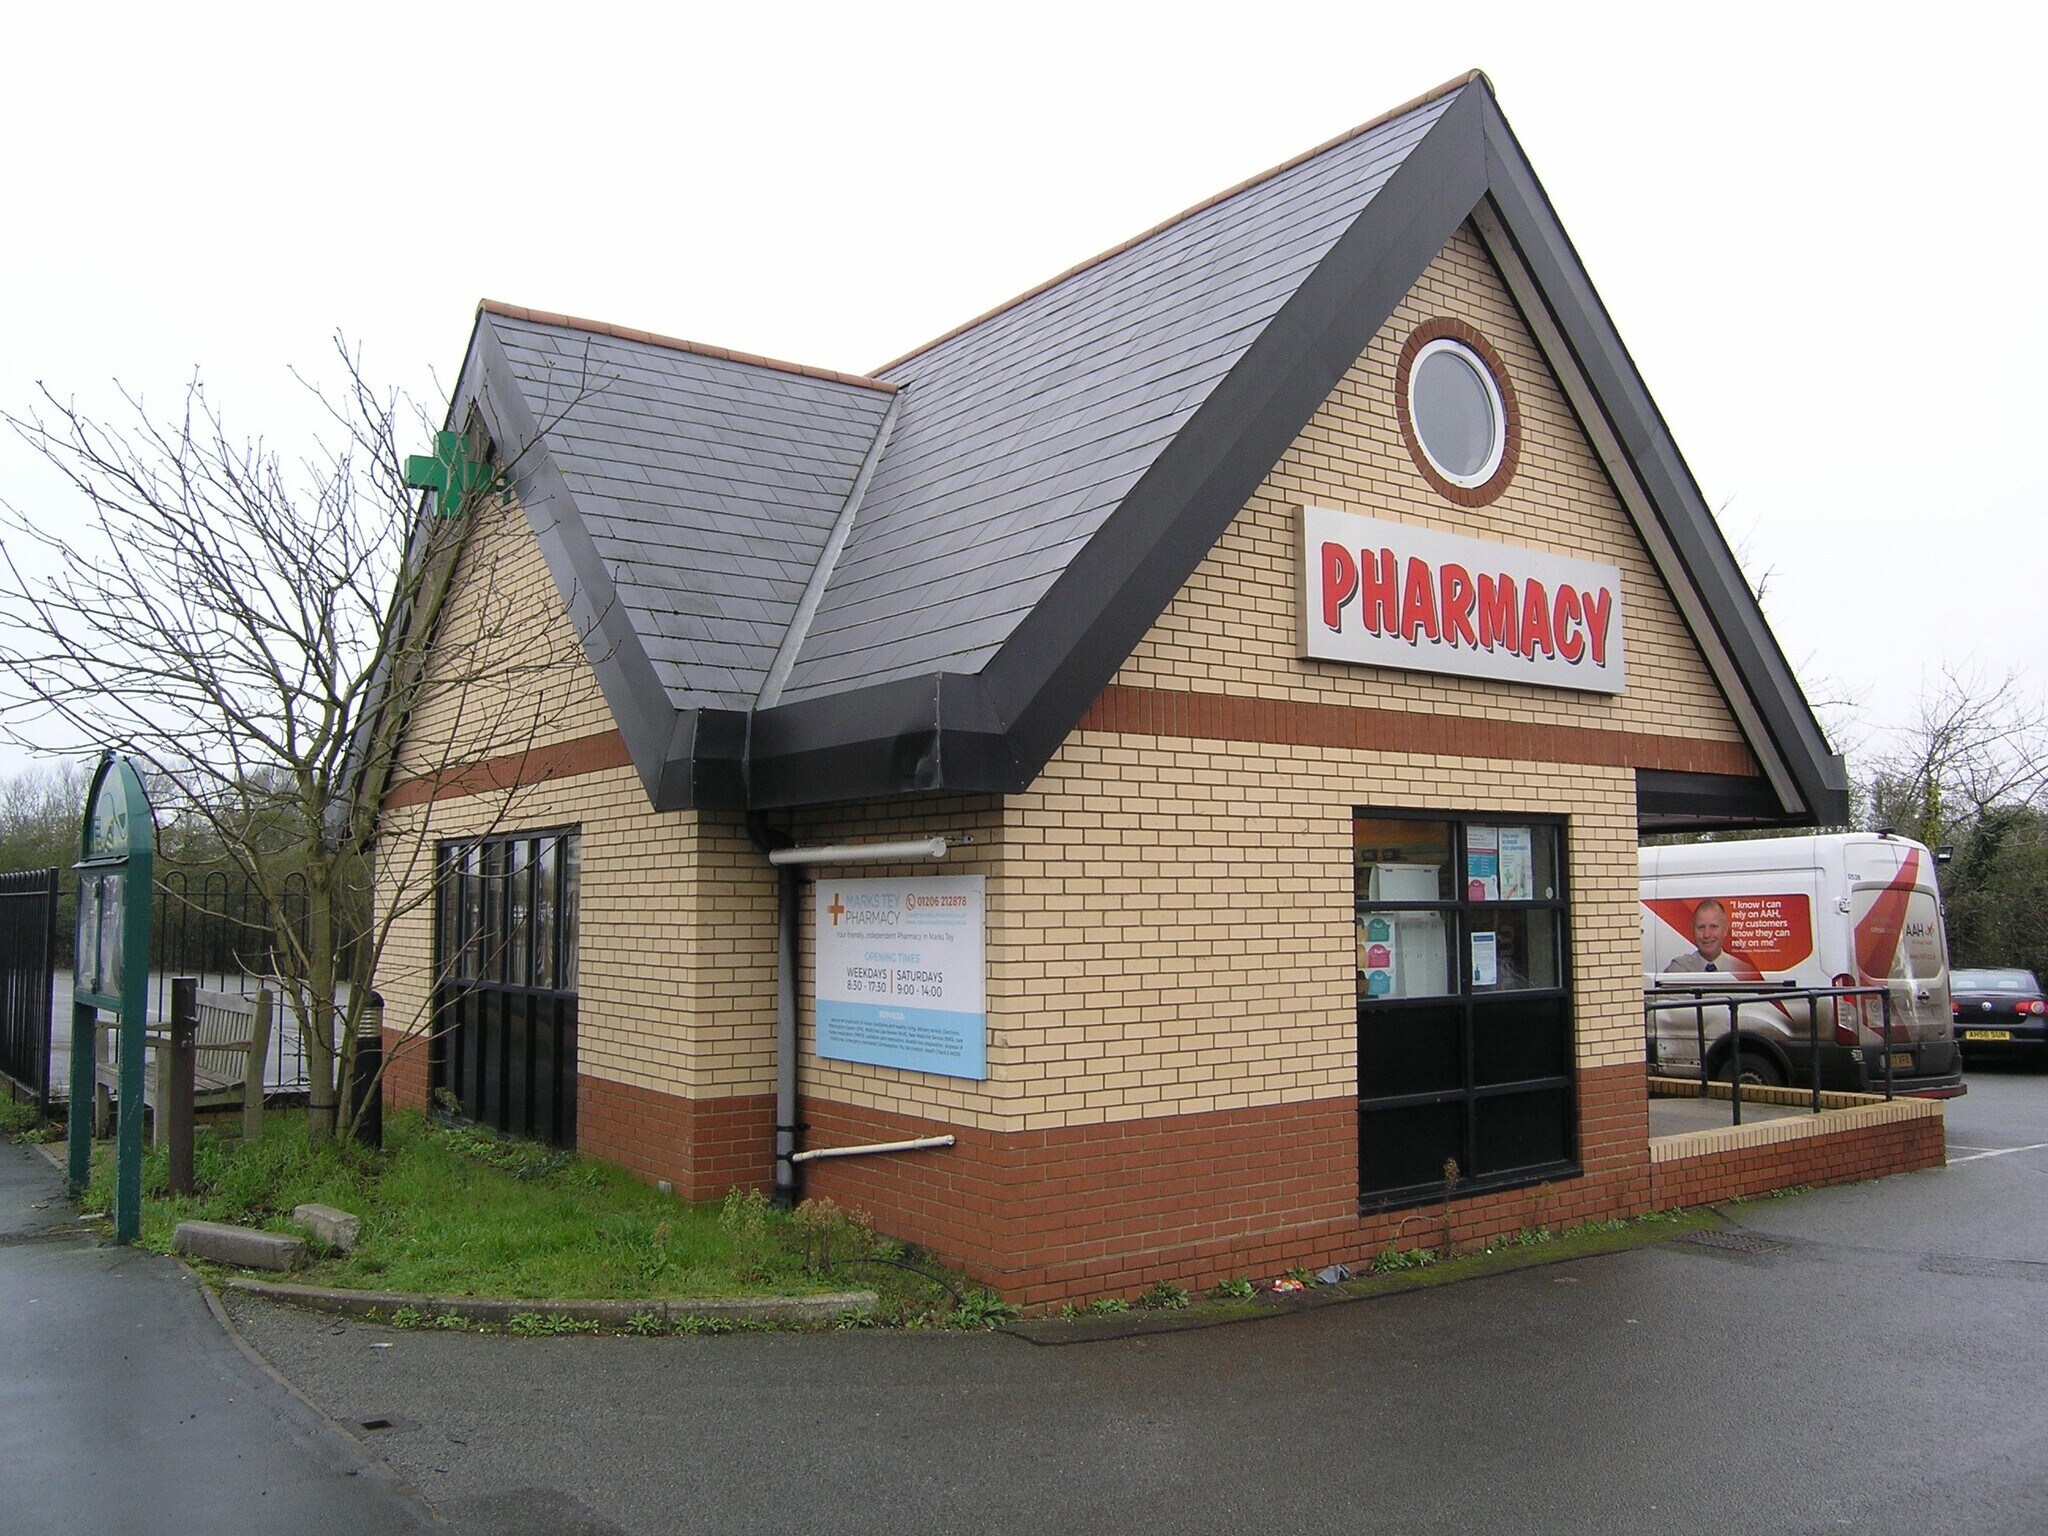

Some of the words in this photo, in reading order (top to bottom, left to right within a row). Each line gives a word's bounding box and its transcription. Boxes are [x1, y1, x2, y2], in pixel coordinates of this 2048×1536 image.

[1321, 541, 1612, 668] PHARMACY
[846, 894, 880, 908] MARKS
[881, 894, 901, 909] TEY
[917, 896, 940, 907] 01206
[941, 896, 967, 907] 212878
[1738, 901, 1760, 909] know
[845, 910, 901, 926] PHARMACY
[1731, 910, 1746, 920] rely
[1760, 909, 1781, 919] AAH,
[1731, 921, 1744, 930] my
[1745, 920, 1788, 928] customers
[1905, 923, 1924, 937] AAH
[897, 932, 921, 942] Pharmacy
[929, 933, 945, 941] Marks
[945, 933, 954, 942] Tey
[1731, 929, 1754, 938] know
[1755, 929, 1773, 939] they
[1731, 939, 1746, 949] rely
[864, 952, 897, 962] OPENING
[898, 953, 921, 963] TIMES
[846, 967, 888, 980] WEEKDAYS
[896, 969, 943, 983] SATURDAYS
